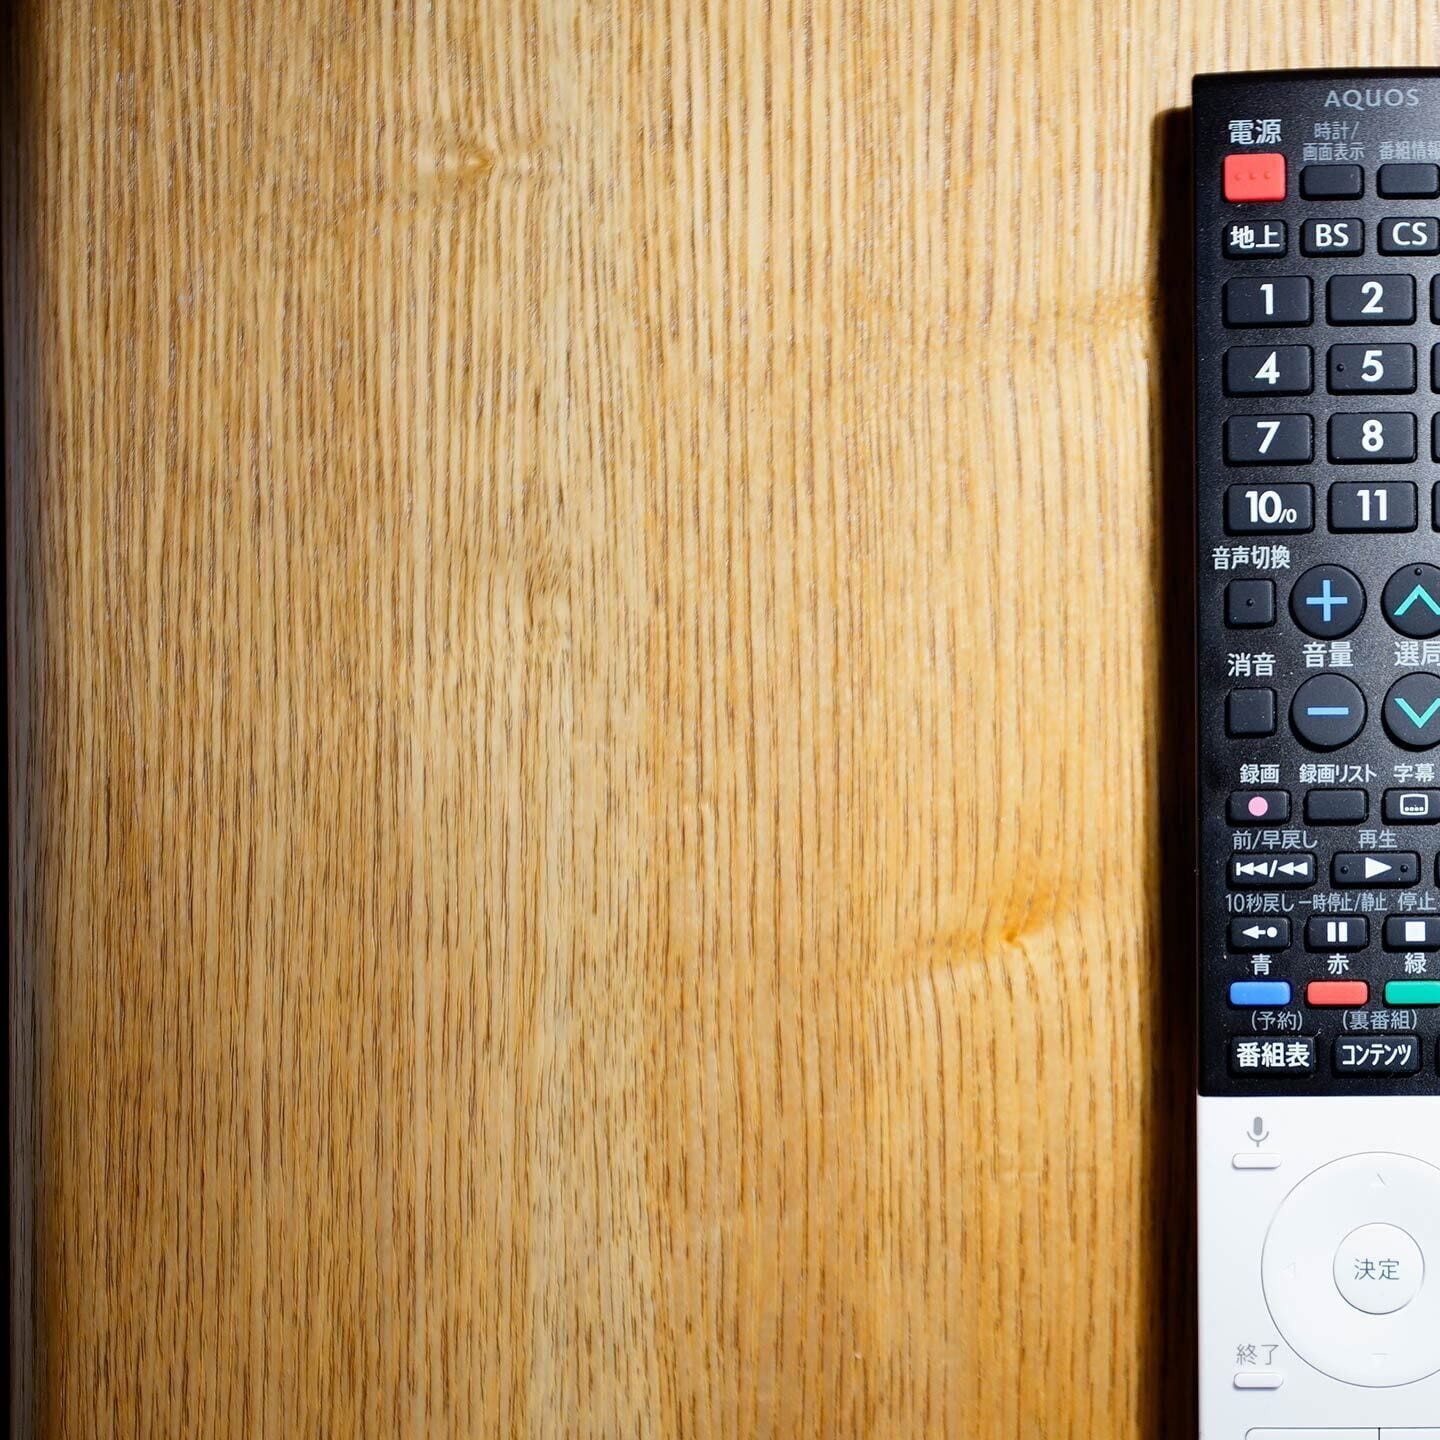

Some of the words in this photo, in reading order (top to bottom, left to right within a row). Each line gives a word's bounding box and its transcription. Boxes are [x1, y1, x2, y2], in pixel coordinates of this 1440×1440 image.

[1324, 88, 1420, 110] AQUOS
[1228, 119, 1282, 144] 電源
[1302, 142, 1365, 161] 画面表示
[1230, 225, 1281, 248] 地上
[1315, 224, 1349, 246] BS
[1392, 222, 1428, 245] CS
[1260, 284, 1274, 314] 1
[1361, 282, 1383, 313] 2
[1254, 351, 1280, 384] 4
[1361, 351, 1383, 382] 5
[1256, 421, 1280, 453] 7
[1361, 419, 1383, 451] 8
[1357, 490, 1387, 521] 11
[1212, 546, 1291, 570] 音声切換
[1228, 653, 1276, 677] 消音
[1302, 642, 1353, 668] 音量
[1240, 764, 1280, 784] 録画
[1300, 764, 1377, 784] 録画リスト
[1393, 763, 1435, 782] 字幕
[1232, 830, 1318, 849] 前/早戻し
[1358, 830, 1397, 848] 再生
[1225, 893, 1295, 913] 10秒戻し
[1298, 893, 1387, 912] 一時停止/静止
[1398, 893, 1436, 911] 停止
[1251, 954, 1272, 975] 青
[1327, 954, 1349, 975] 赤
[1404, 953, 1427, 973] 緑
[1251, 1012, 1302, 1031] (予約)
[1342, 1010, 1417, 1031] (裏番組)
[1237, 1042, 1310, 1068] 番組表
[1342, 1044, 1411, 1066] コンテンツ
[1353, 1259, 1400, 1281] 決定
[1236, 1344, 1279, 1365] 終了
